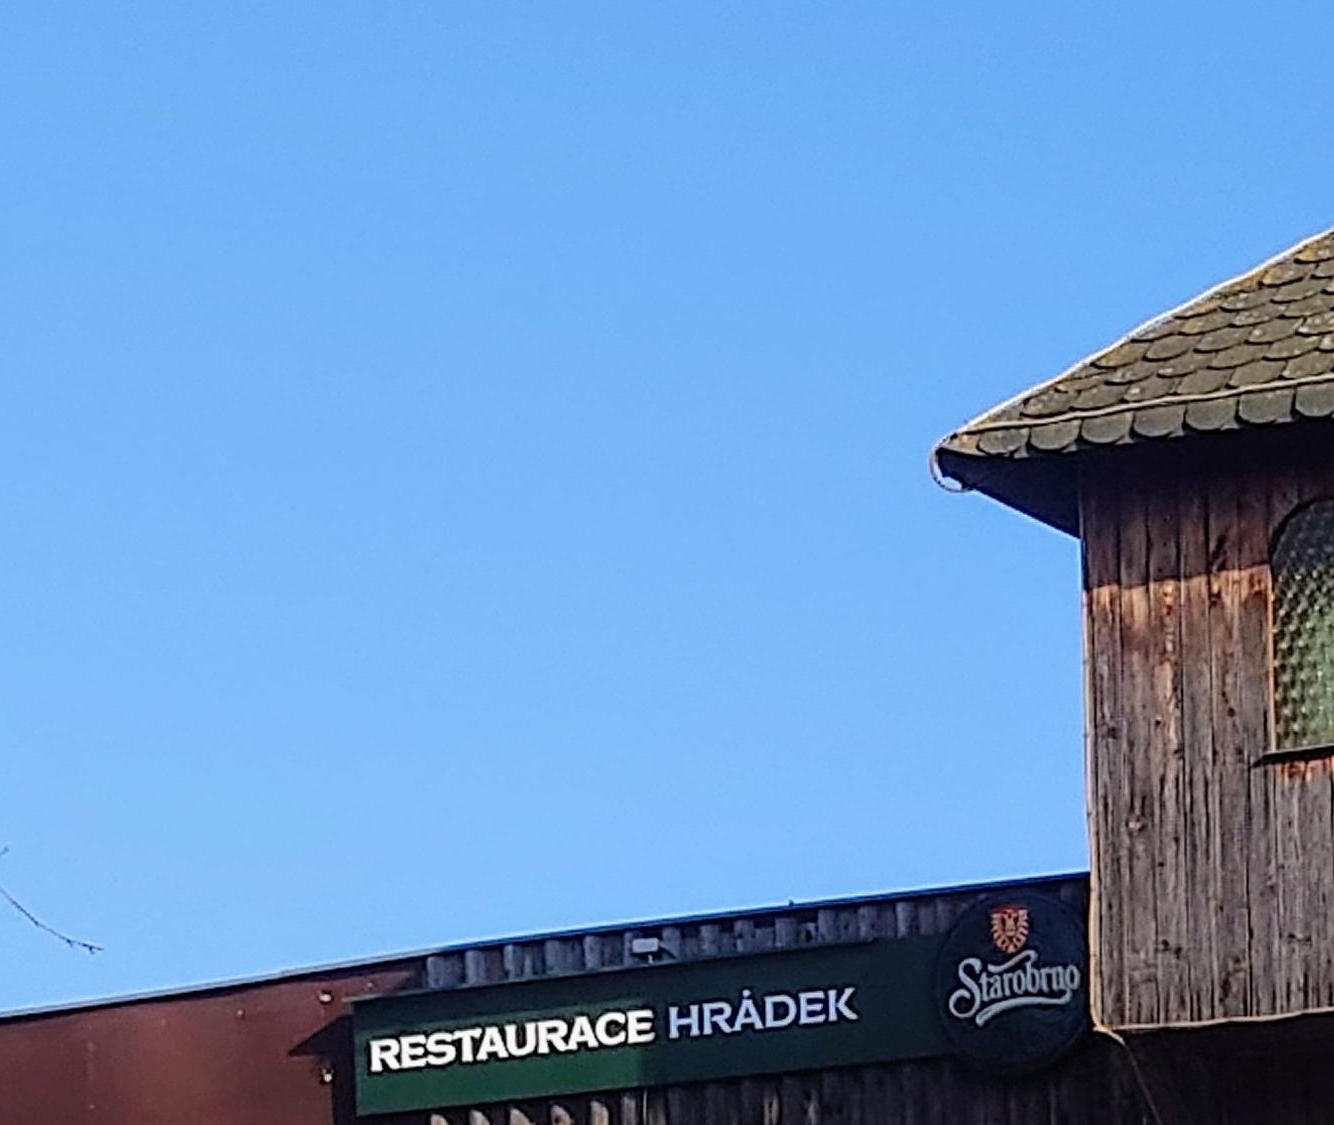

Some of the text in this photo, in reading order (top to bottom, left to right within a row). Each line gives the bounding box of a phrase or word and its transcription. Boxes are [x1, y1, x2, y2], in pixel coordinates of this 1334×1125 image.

[949, 950, 1081, 1025] Starobrno
[369, 987, 859, 1073] RESTAURACE HRÁDEK
